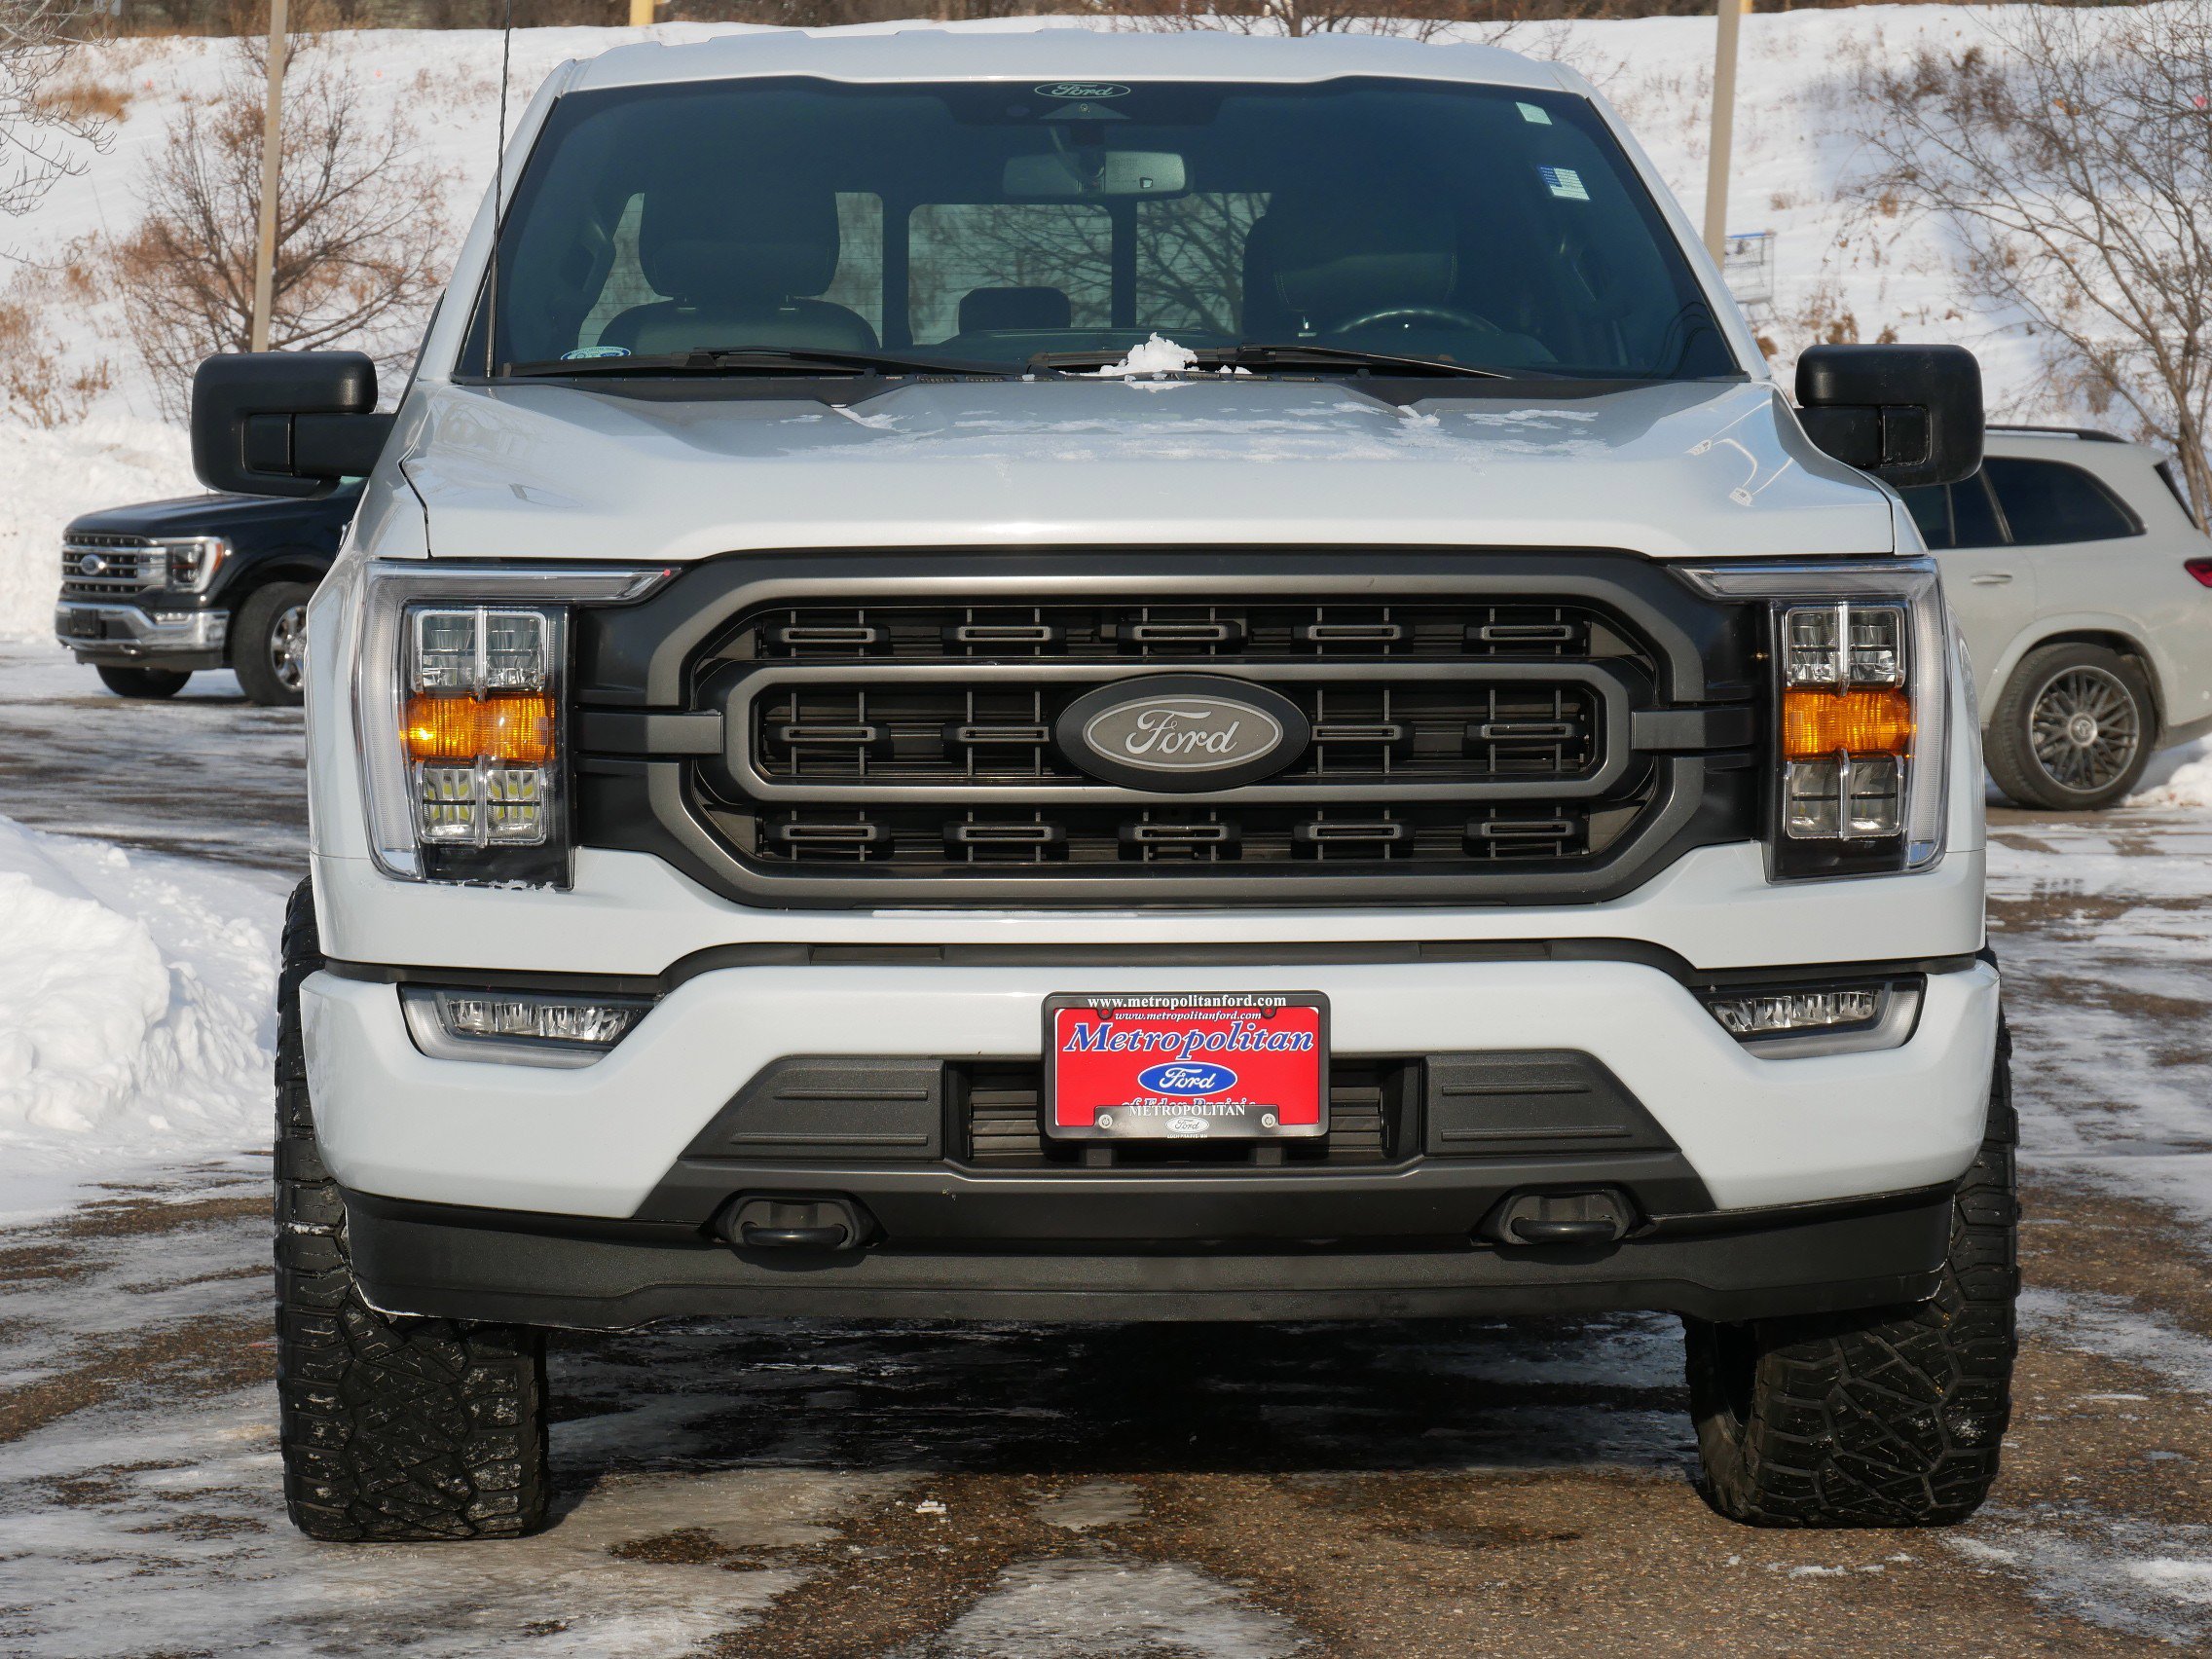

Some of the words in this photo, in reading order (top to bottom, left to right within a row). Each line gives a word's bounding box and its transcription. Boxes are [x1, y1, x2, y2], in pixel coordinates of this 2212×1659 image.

[1051, 84, 1113, 95] Ford
[1124, 710, 1239, 754] Ford
[1088, 994, 1286, 1010] www.metropolitanford.com
[1115, 1011, 1262, 1022] www.metropolitanford.com
[1063, 1021, 1313, 1060] Metropolitan
[1159, 1066, 1215, 1089] Ford
[1128, 1105, 1246, 1117] METROPOLITAN
